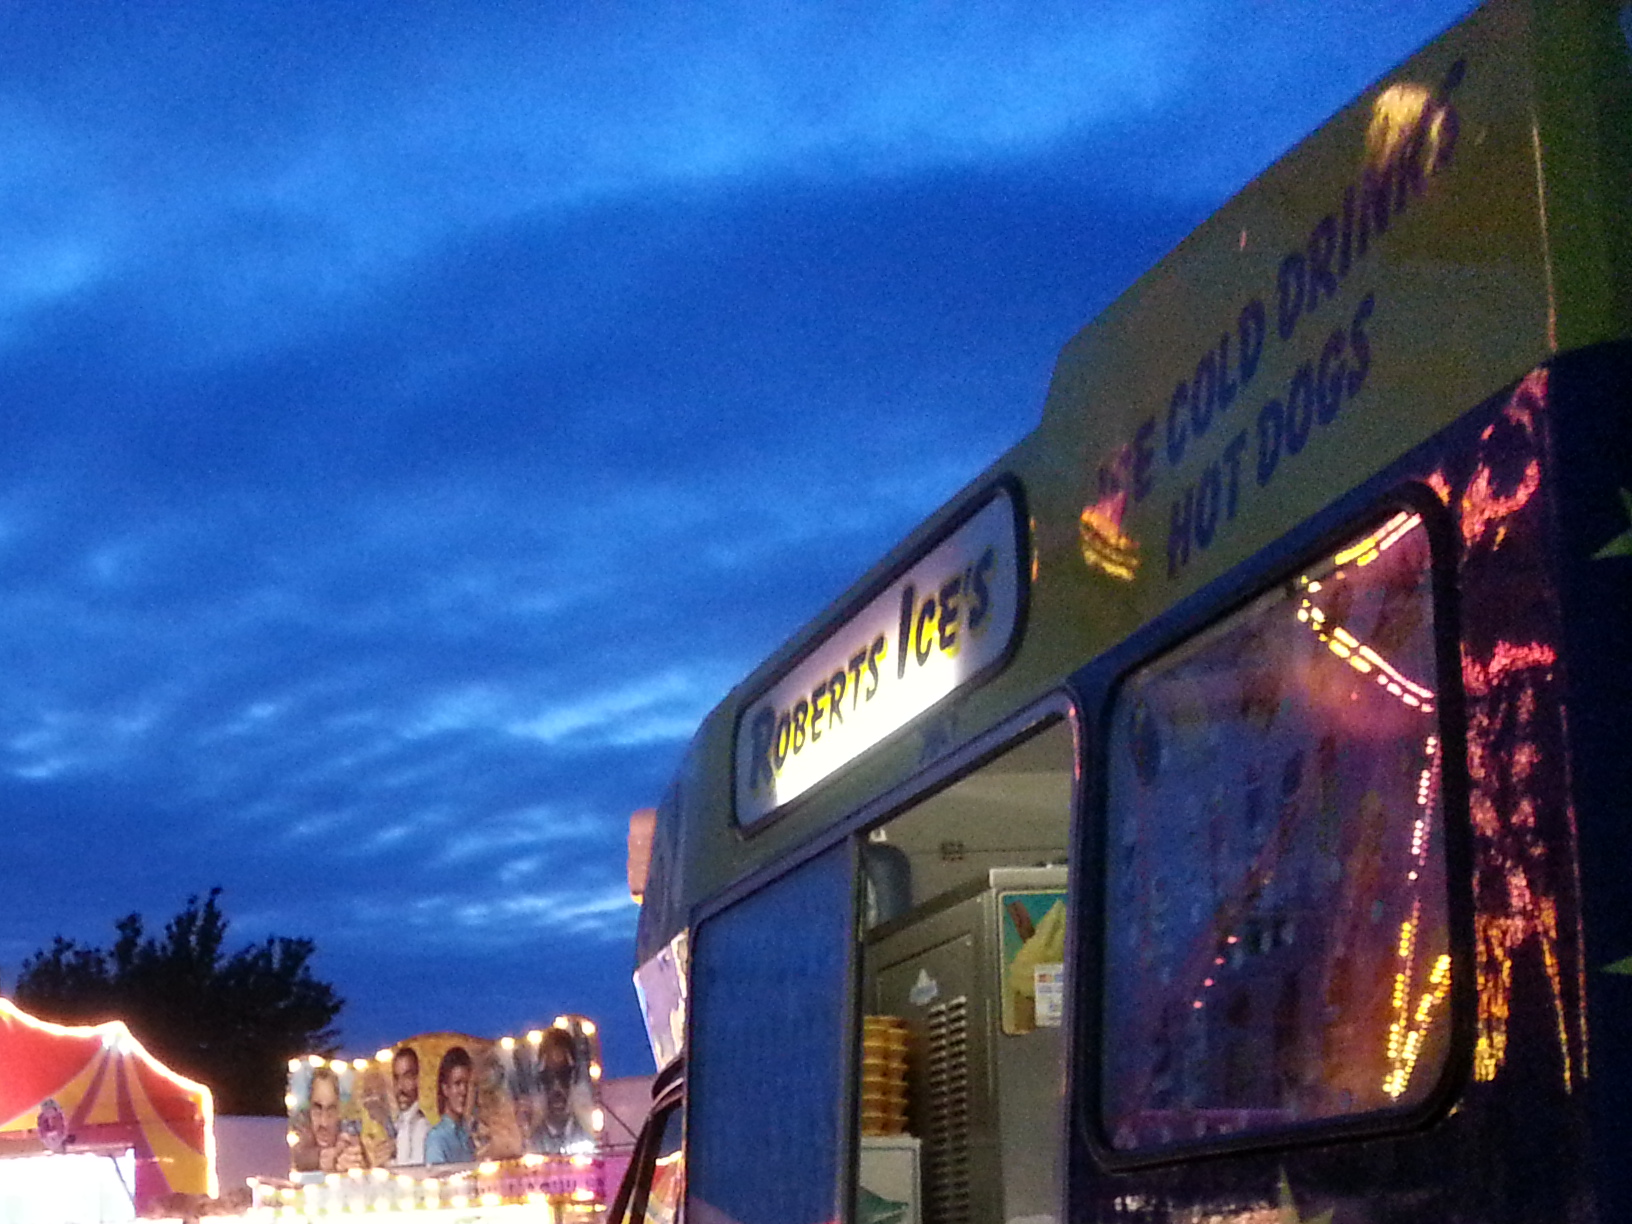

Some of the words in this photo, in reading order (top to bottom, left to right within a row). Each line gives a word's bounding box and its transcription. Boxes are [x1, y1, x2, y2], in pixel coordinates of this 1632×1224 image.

[1168, 300, 1266, 466] COLD
[1169, 428, 1248, 576] HOT
[1257, 293, 1375, 489] DOGS
